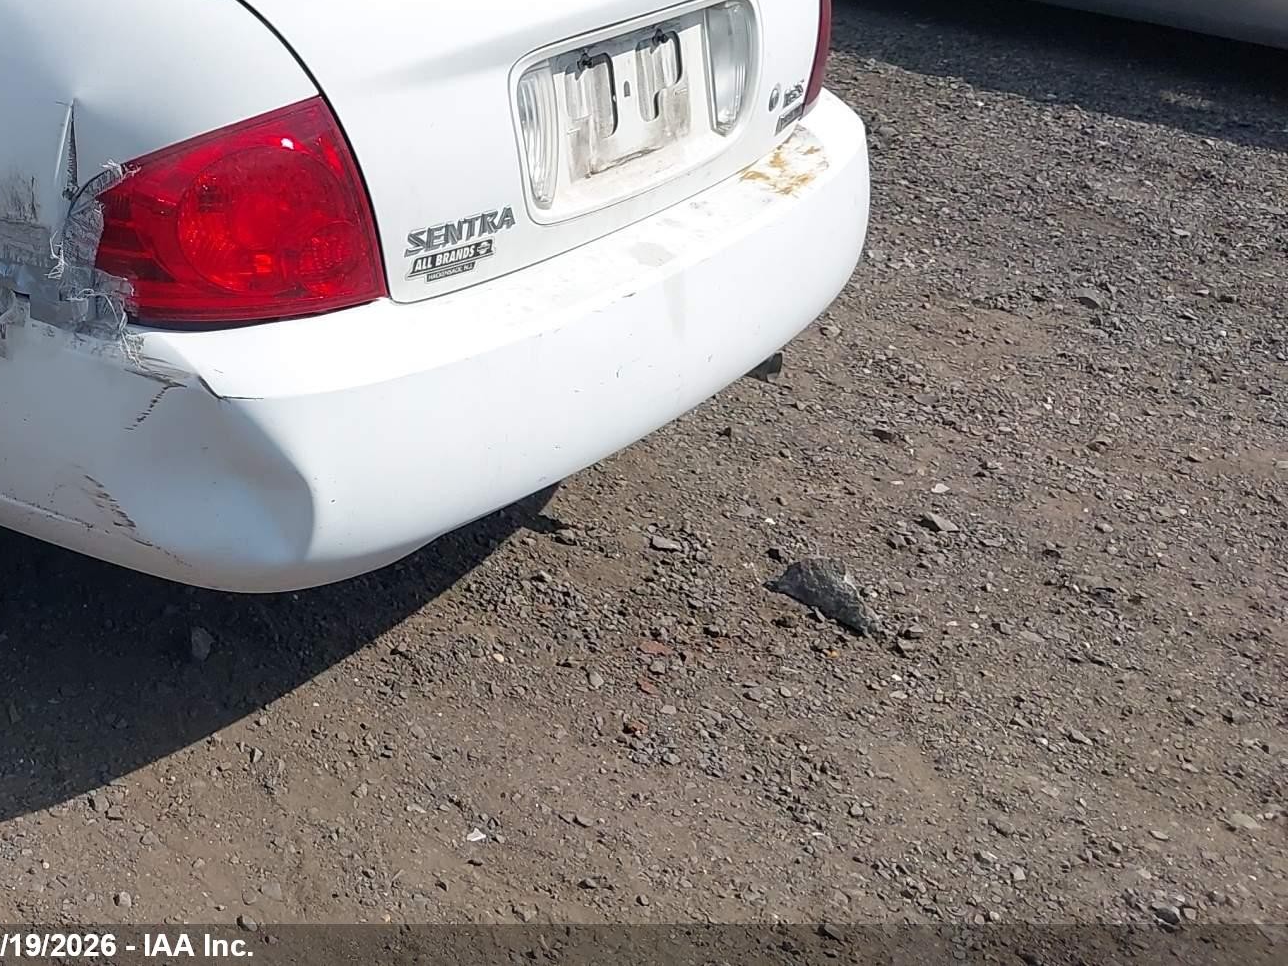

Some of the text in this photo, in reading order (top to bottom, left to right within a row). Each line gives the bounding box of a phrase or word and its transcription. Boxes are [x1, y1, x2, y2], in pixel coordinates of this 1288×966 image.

[404, 207, 516, 258] SENTRA
[414, 244, 475, 273] ALL BRANDS
